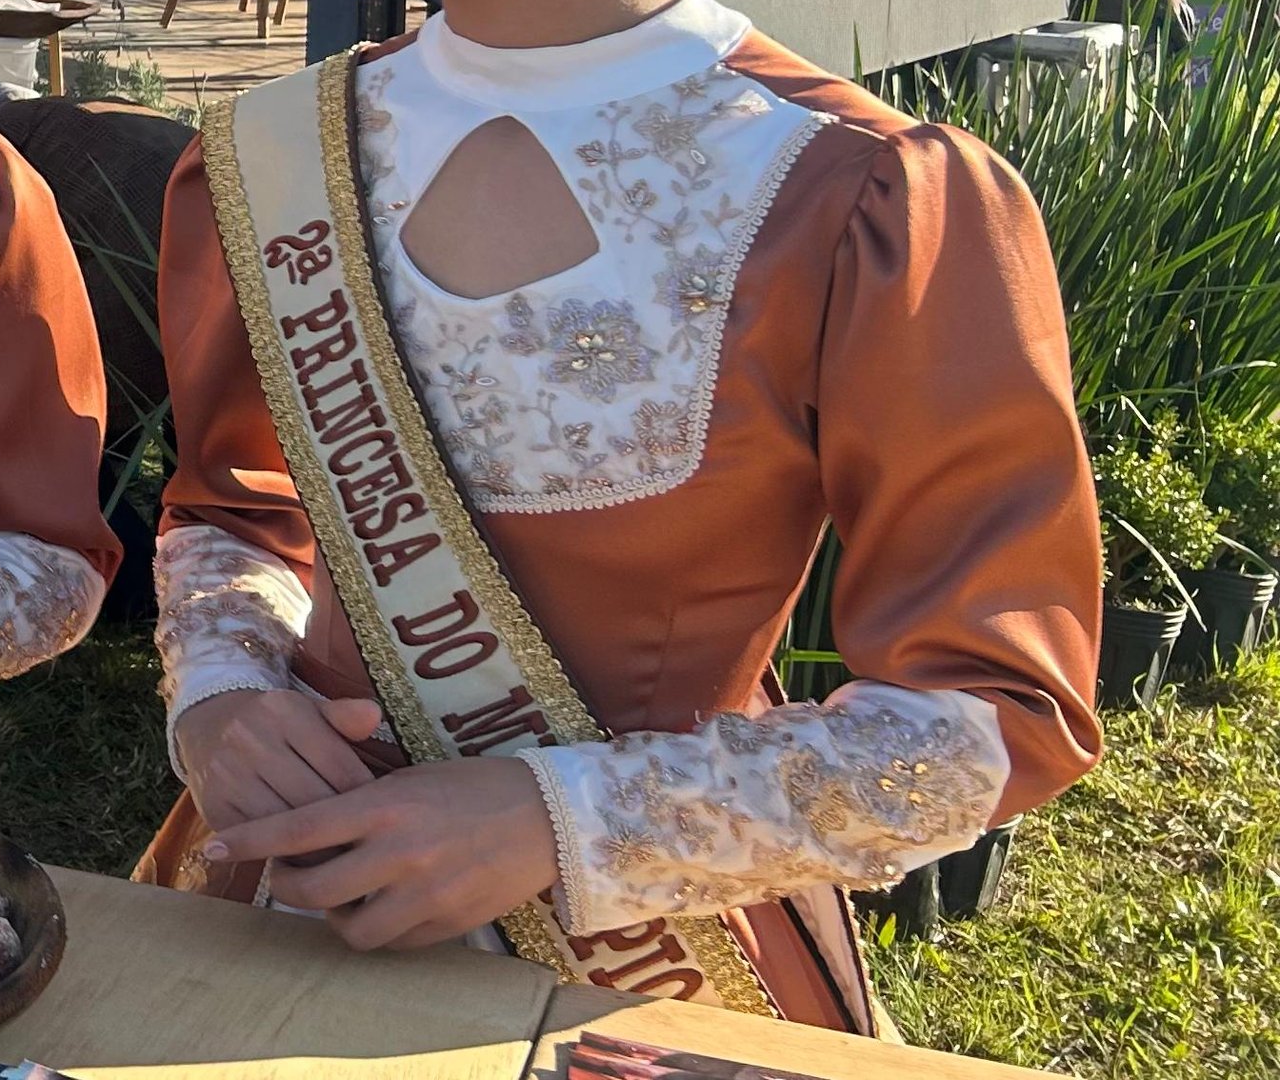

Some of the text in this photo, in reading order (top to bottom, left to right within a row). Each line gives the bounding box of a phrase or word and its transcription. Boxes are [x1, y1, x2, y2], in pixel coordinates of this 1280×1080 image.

[279, 288, 441, 589] PRINCESA
[392, 589, 480, 680] DO
[441, 685, 557, 757] M
